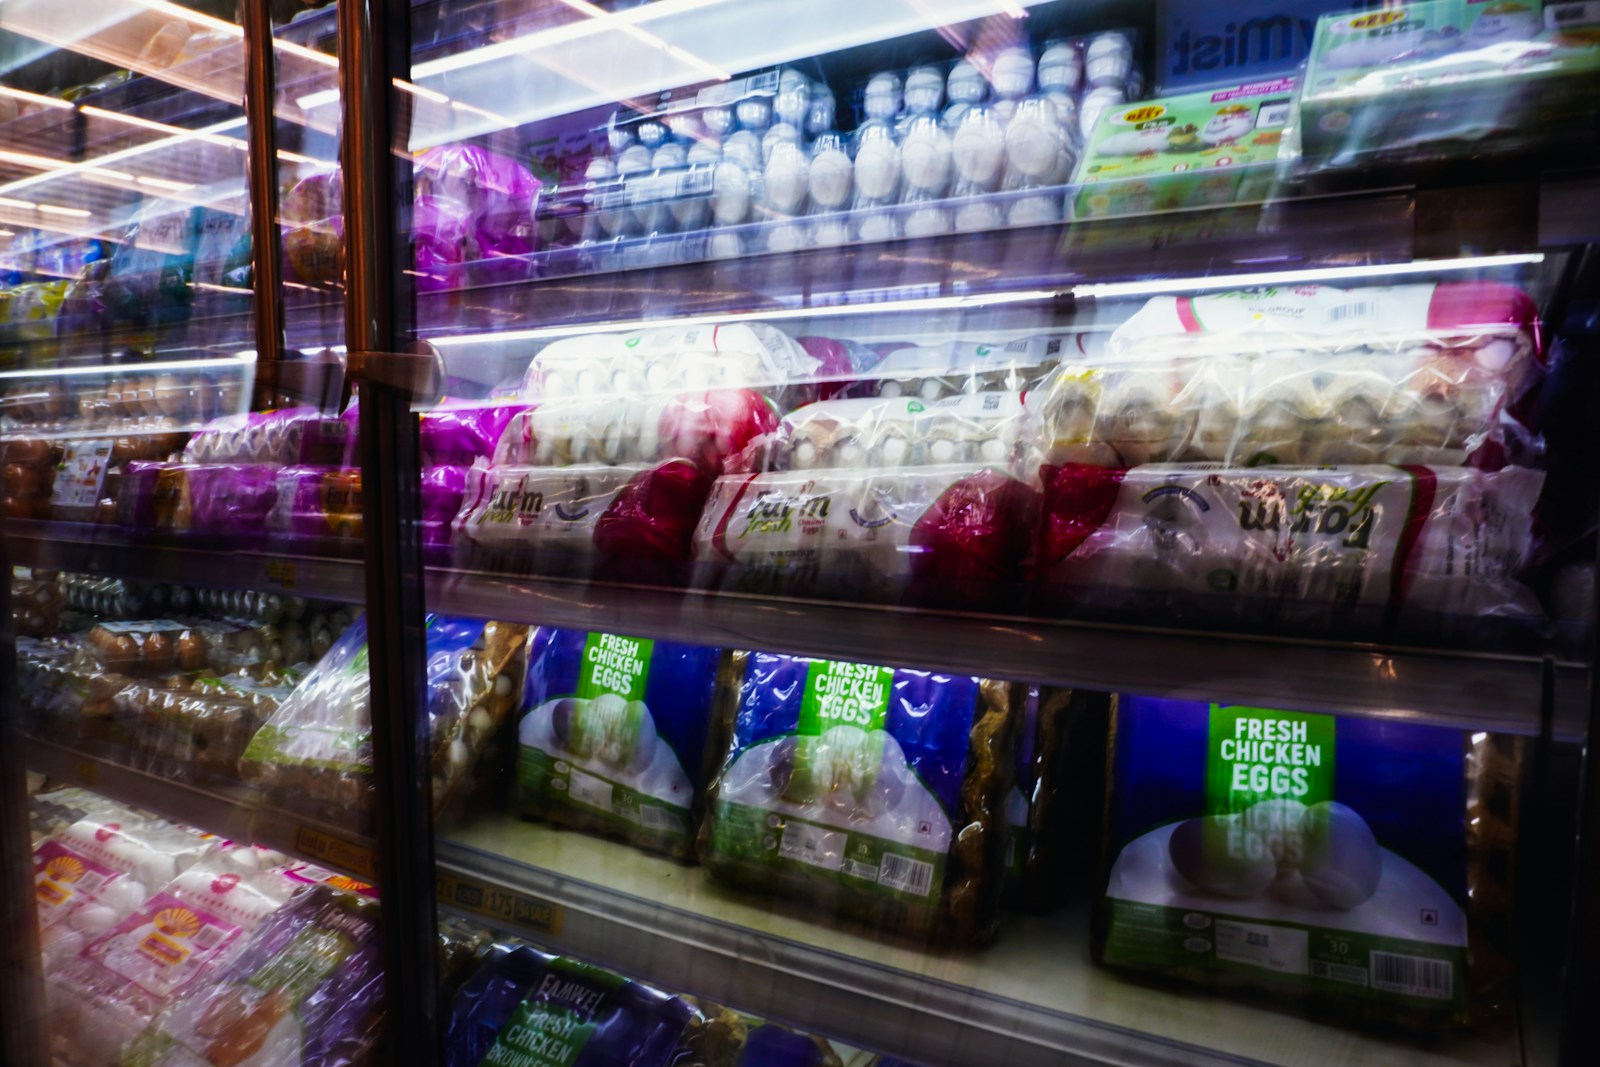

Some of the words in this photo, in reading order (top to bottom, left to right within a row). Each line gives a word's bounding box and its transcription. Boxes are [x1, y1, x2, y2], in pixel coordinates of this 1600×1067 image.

[1238, 503, 1375, 549] Farm
[600, 632, 639, 657] FRESH
[588, 646, 644, 677] CHICKEN
[828, 660, 879, 682] FRESH
[591, 664, 633, 695] EGGS
[814, 673, 884, 704] CHICKEN
[820, 693, 872, 726] EGGS
[1235, 717, 1307, 743] FRESH
[1220, 739, 1321, 767] CHICKEN
[1231, 763, 1309, 796] EGGS
[1329, 940, 1350, 956] 30
[486, 1043, 533, 1067] BROWN
[506, 1024, 574, 1064] CHICKEN
